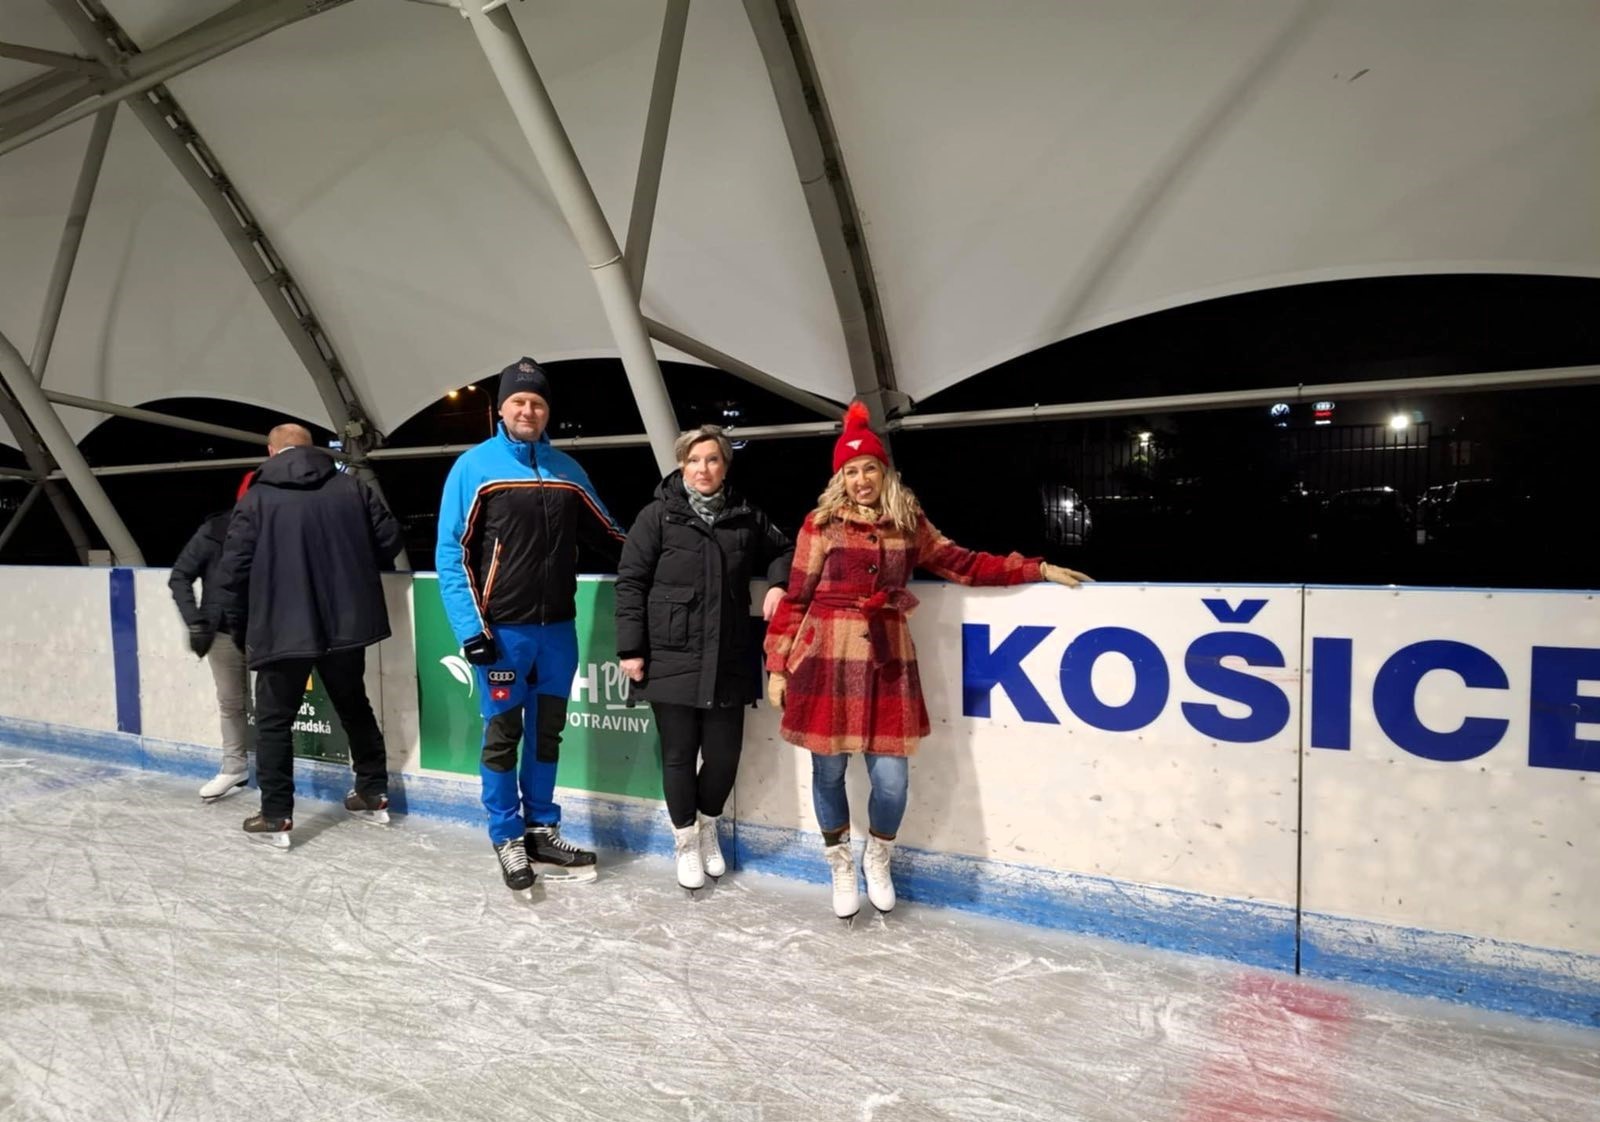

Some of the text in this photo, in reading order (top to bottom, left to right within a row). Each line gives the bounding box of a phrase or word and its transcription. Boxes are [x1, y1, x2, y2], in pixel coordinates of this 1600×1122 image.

[962, 598, 1600, 773] KOŠICE
[297, 702, 315, 716] d's
[566, 712, 650, 733] OTRAVINY
